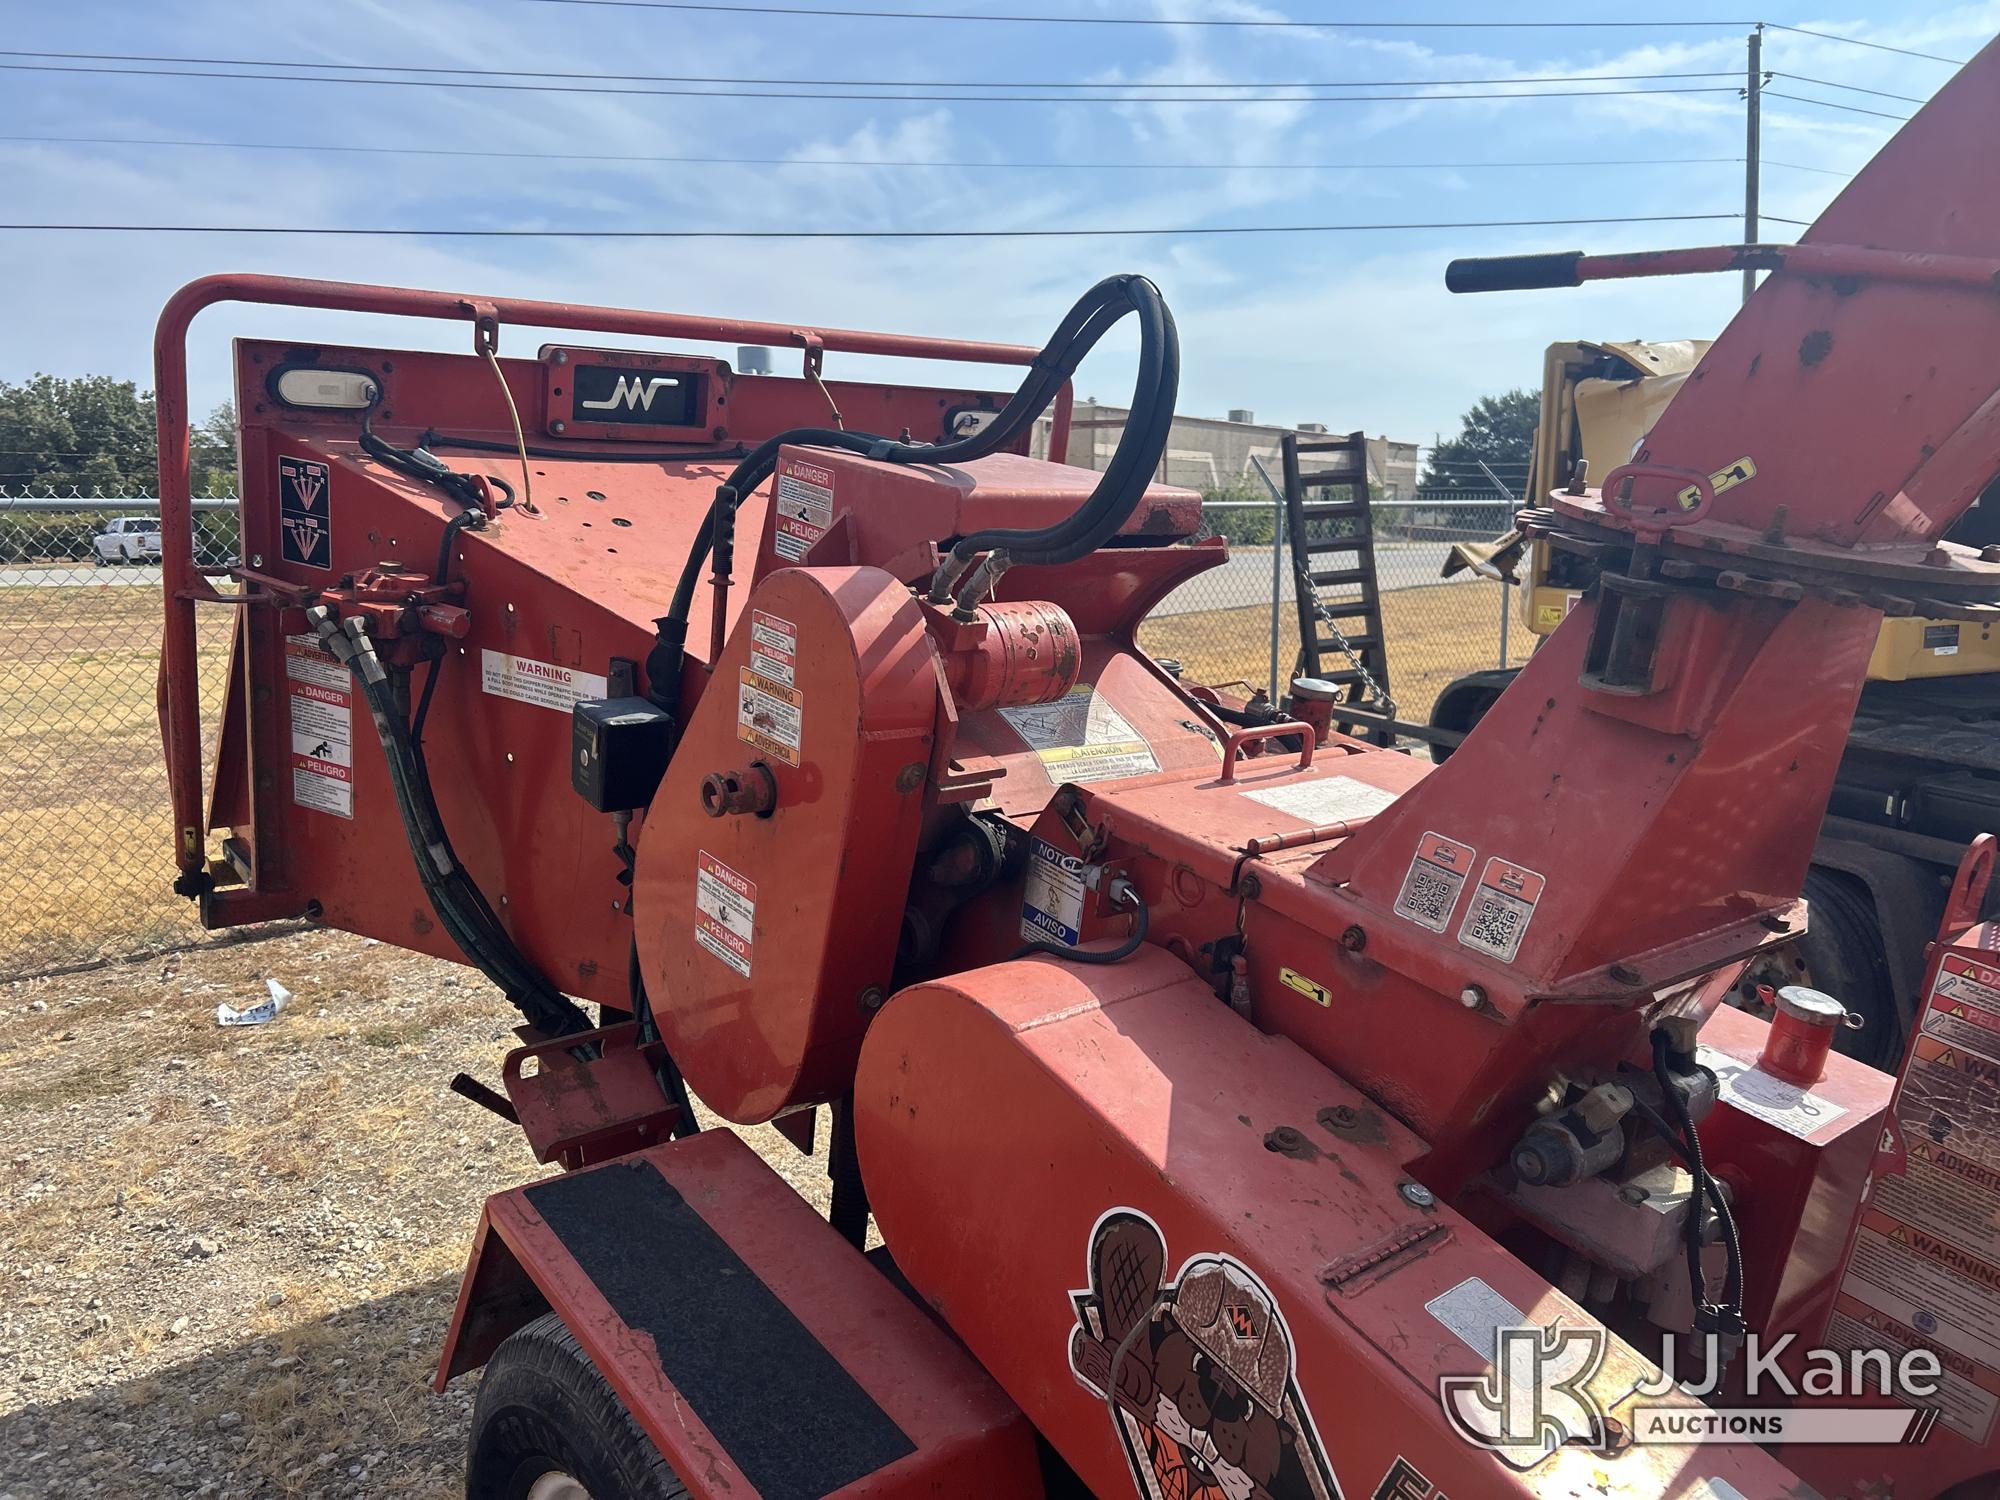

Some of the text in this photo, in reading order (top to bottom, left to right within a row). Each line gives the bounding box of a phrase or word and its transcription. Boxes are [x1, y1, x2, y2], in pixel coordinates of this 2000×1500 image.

[794, 465, 828, 485] DANGER
[790, 522, 822, 541] PELIGR
[765, 617, 790, 634] DANGER
[764, 646, 788, 663] PELIGRO
[516, 660, 572, 682] WARNING
[305, 687, 343, 704] DANGER
[554, 686, 571, 695] TRAFFIC
[757, 677, 793, 702] WARNING
[755, 734, 790, 760] ADVERTENCIA
[307, 760, 346, 778] PELIGRO
[1038, 843, 1078, 871] NOT
[715, 865, 748, 894] DANGER
[1034, 913, 1066, 938] AVISO
[710, 922, 745, 953] PELIGRO
[1936, 1151, 2000, 1191] ADVERTE
[1910, 1251, 1943, 1271] BEFORE
[1945, 1268, 1993, 1296] OPERATING
